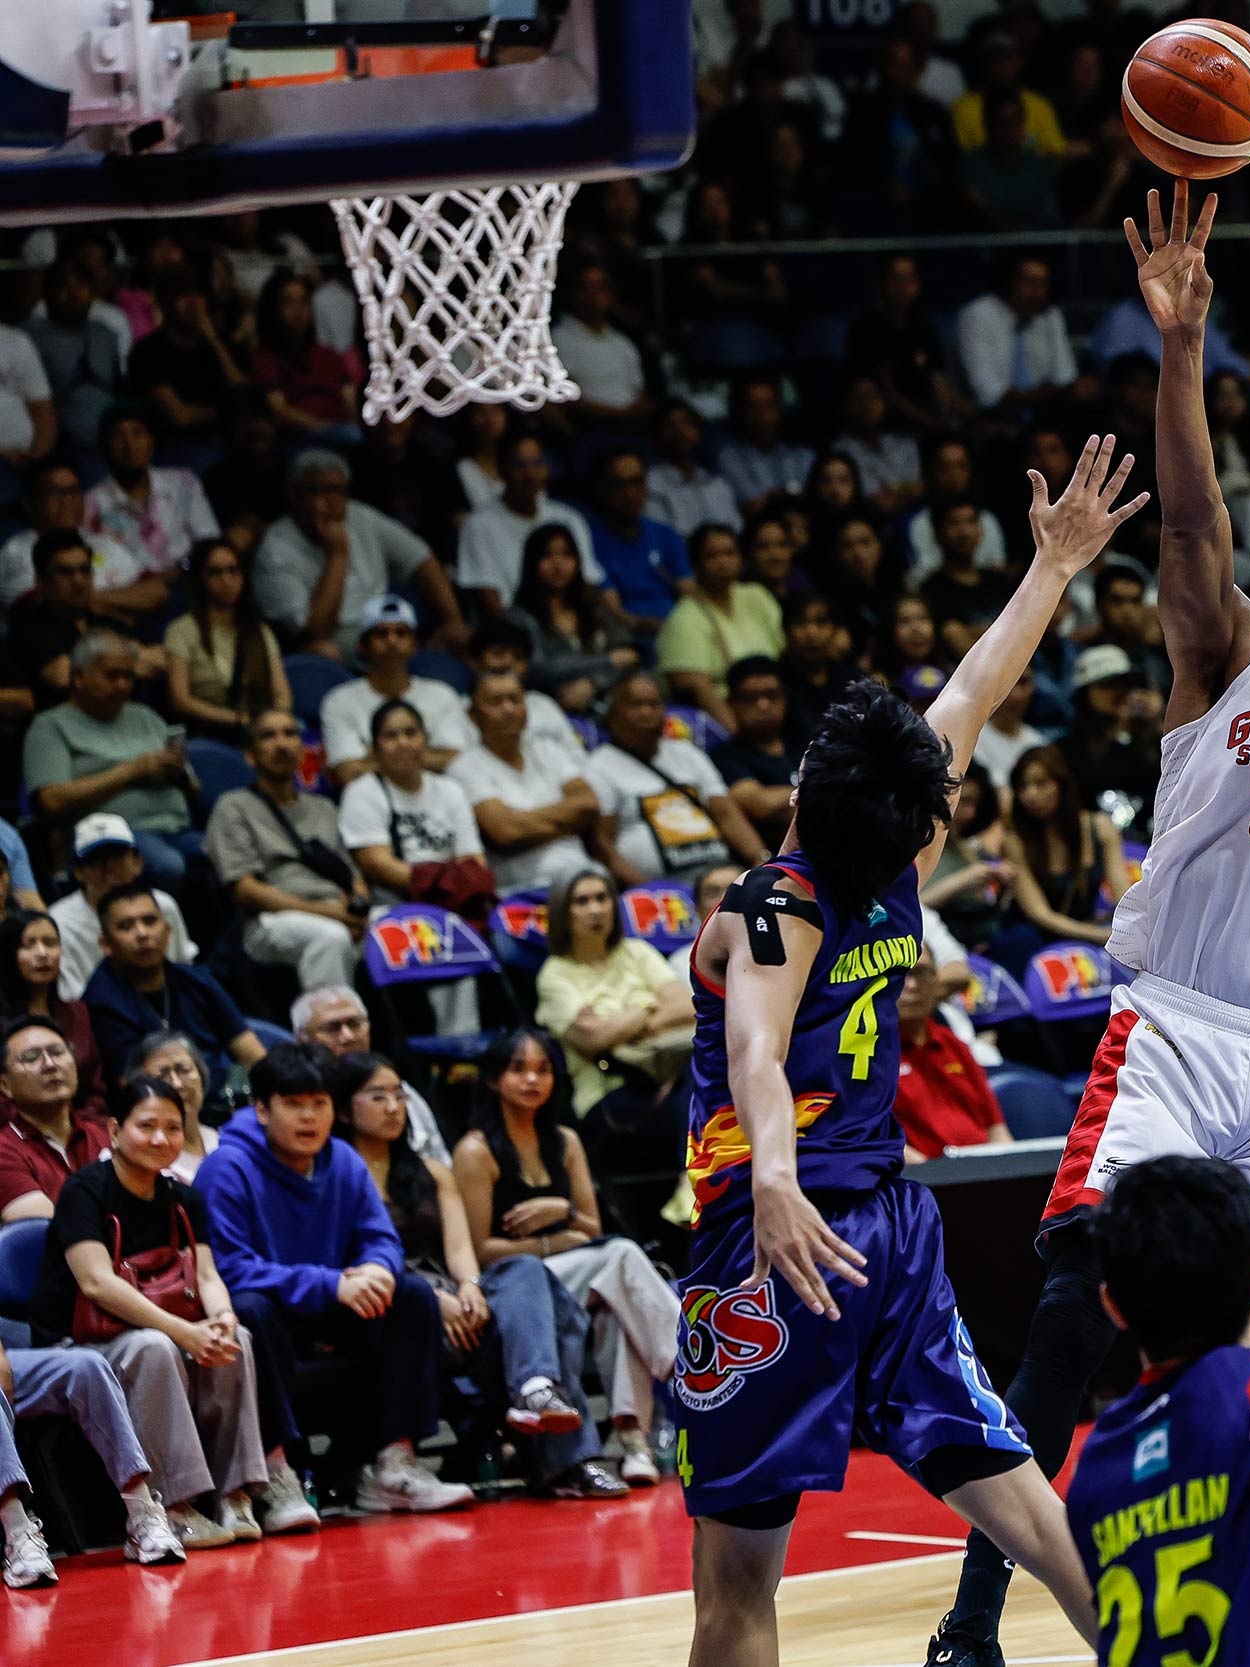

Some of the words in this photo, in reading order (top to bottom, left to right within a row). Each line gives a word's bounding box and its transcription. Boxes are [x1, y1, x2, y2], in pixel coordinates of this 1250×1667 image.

[829, 934, 918, 985] MALONZO
[837, 974, 890, 1081] 4
[676, 1427, 695, 1488] 4
[1096, 1531, 1233, 1667] 25
